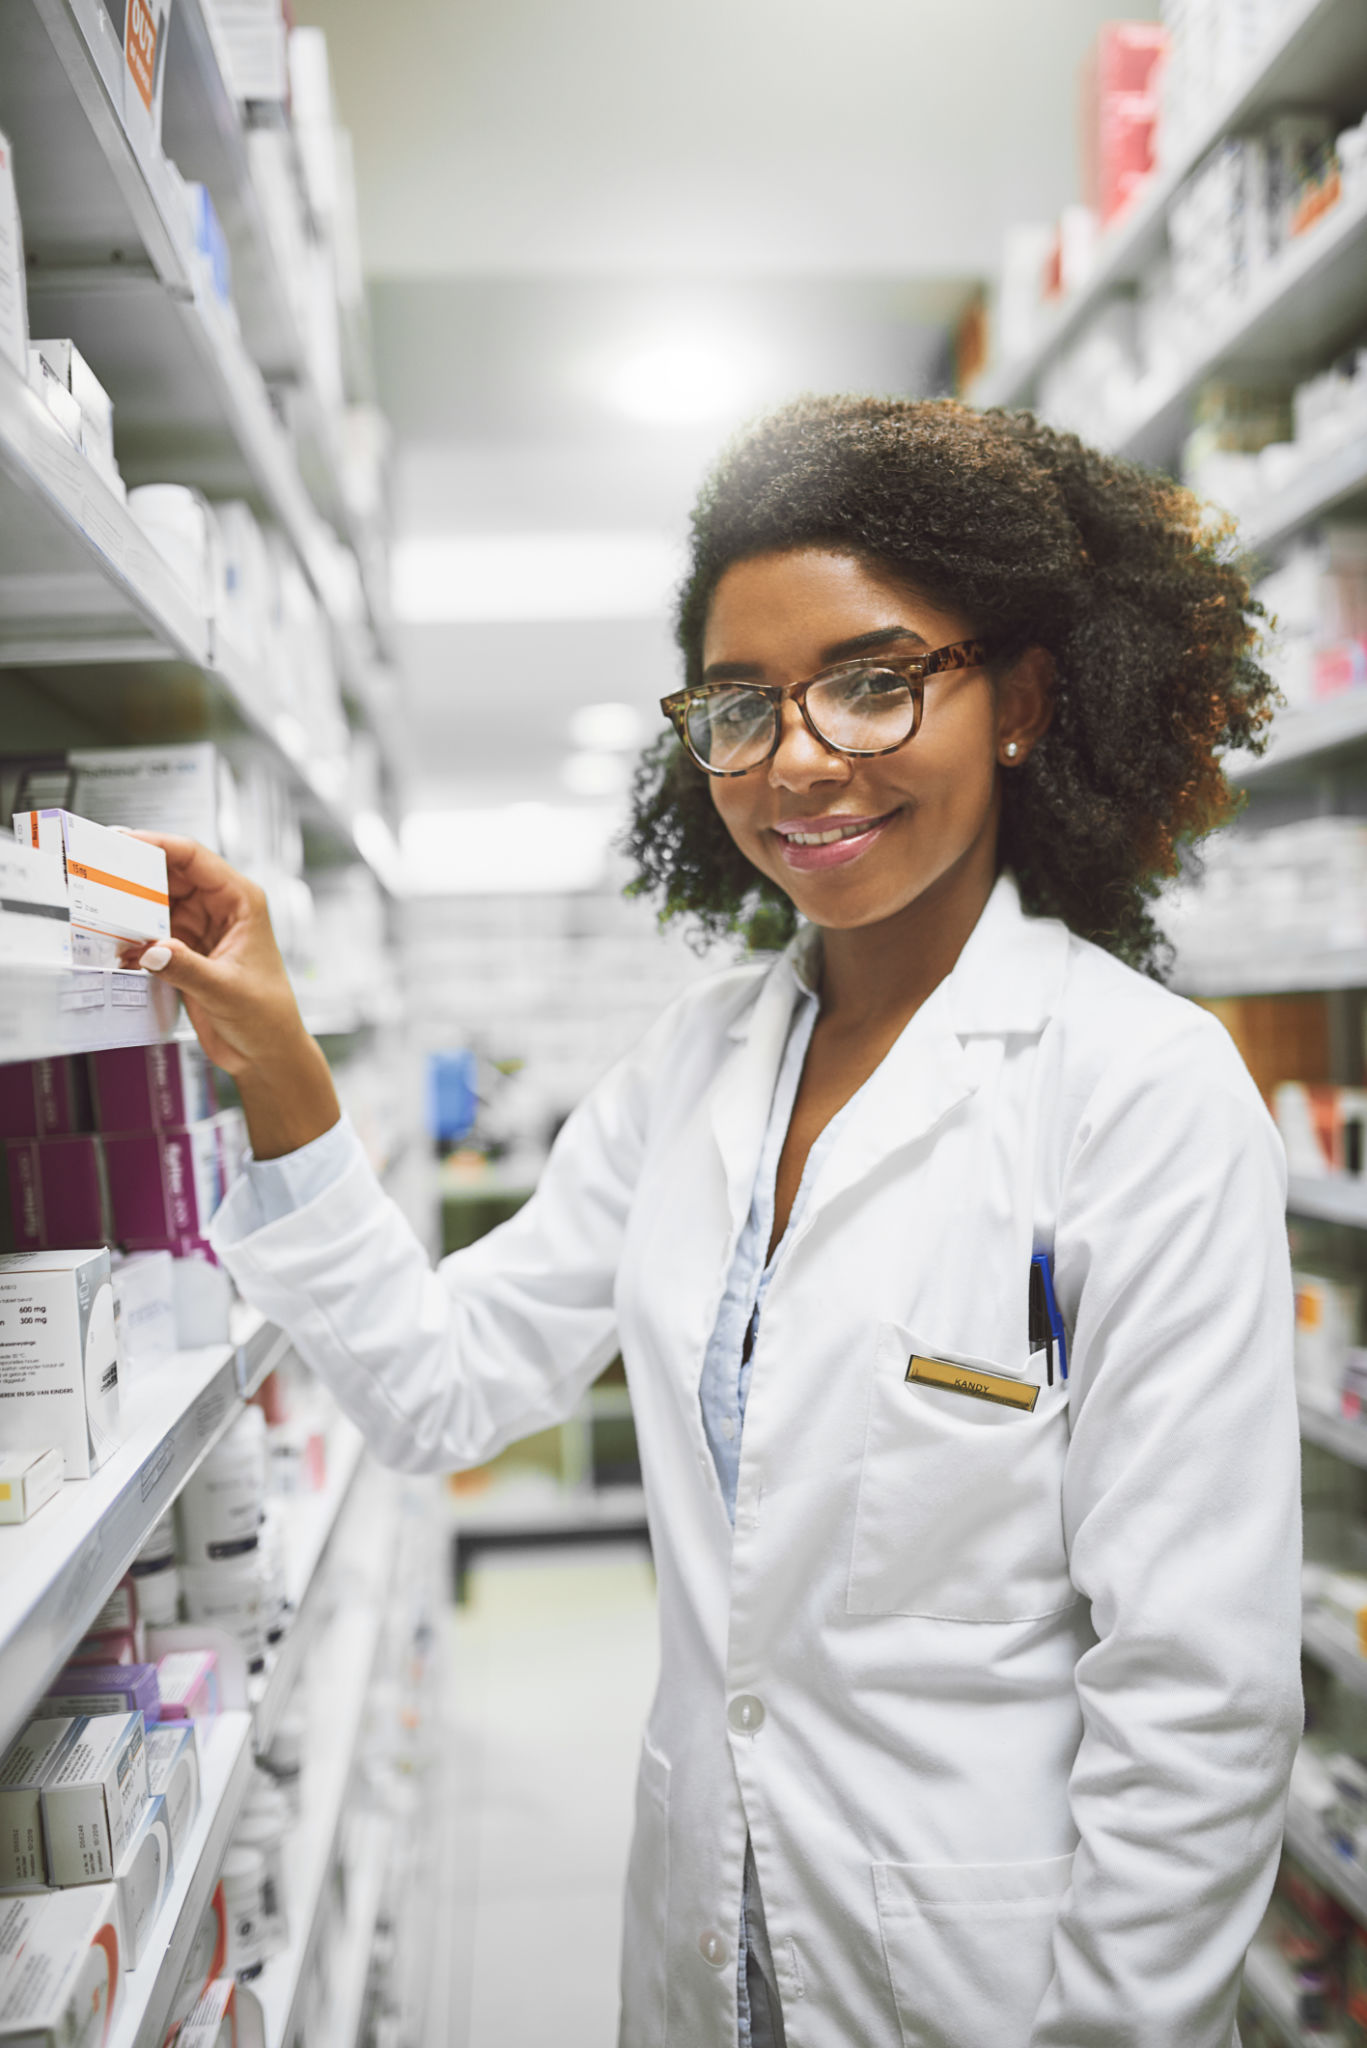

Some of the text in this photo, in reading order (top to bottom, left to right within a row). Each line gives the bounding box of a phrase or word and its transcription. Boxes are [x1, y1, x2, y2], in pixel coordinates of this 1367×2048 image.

[73, 864, 87, 879] 15 mg
[35, 1317, 47, 1325] mg
[954, 1378, 990, 1393] KANDY
